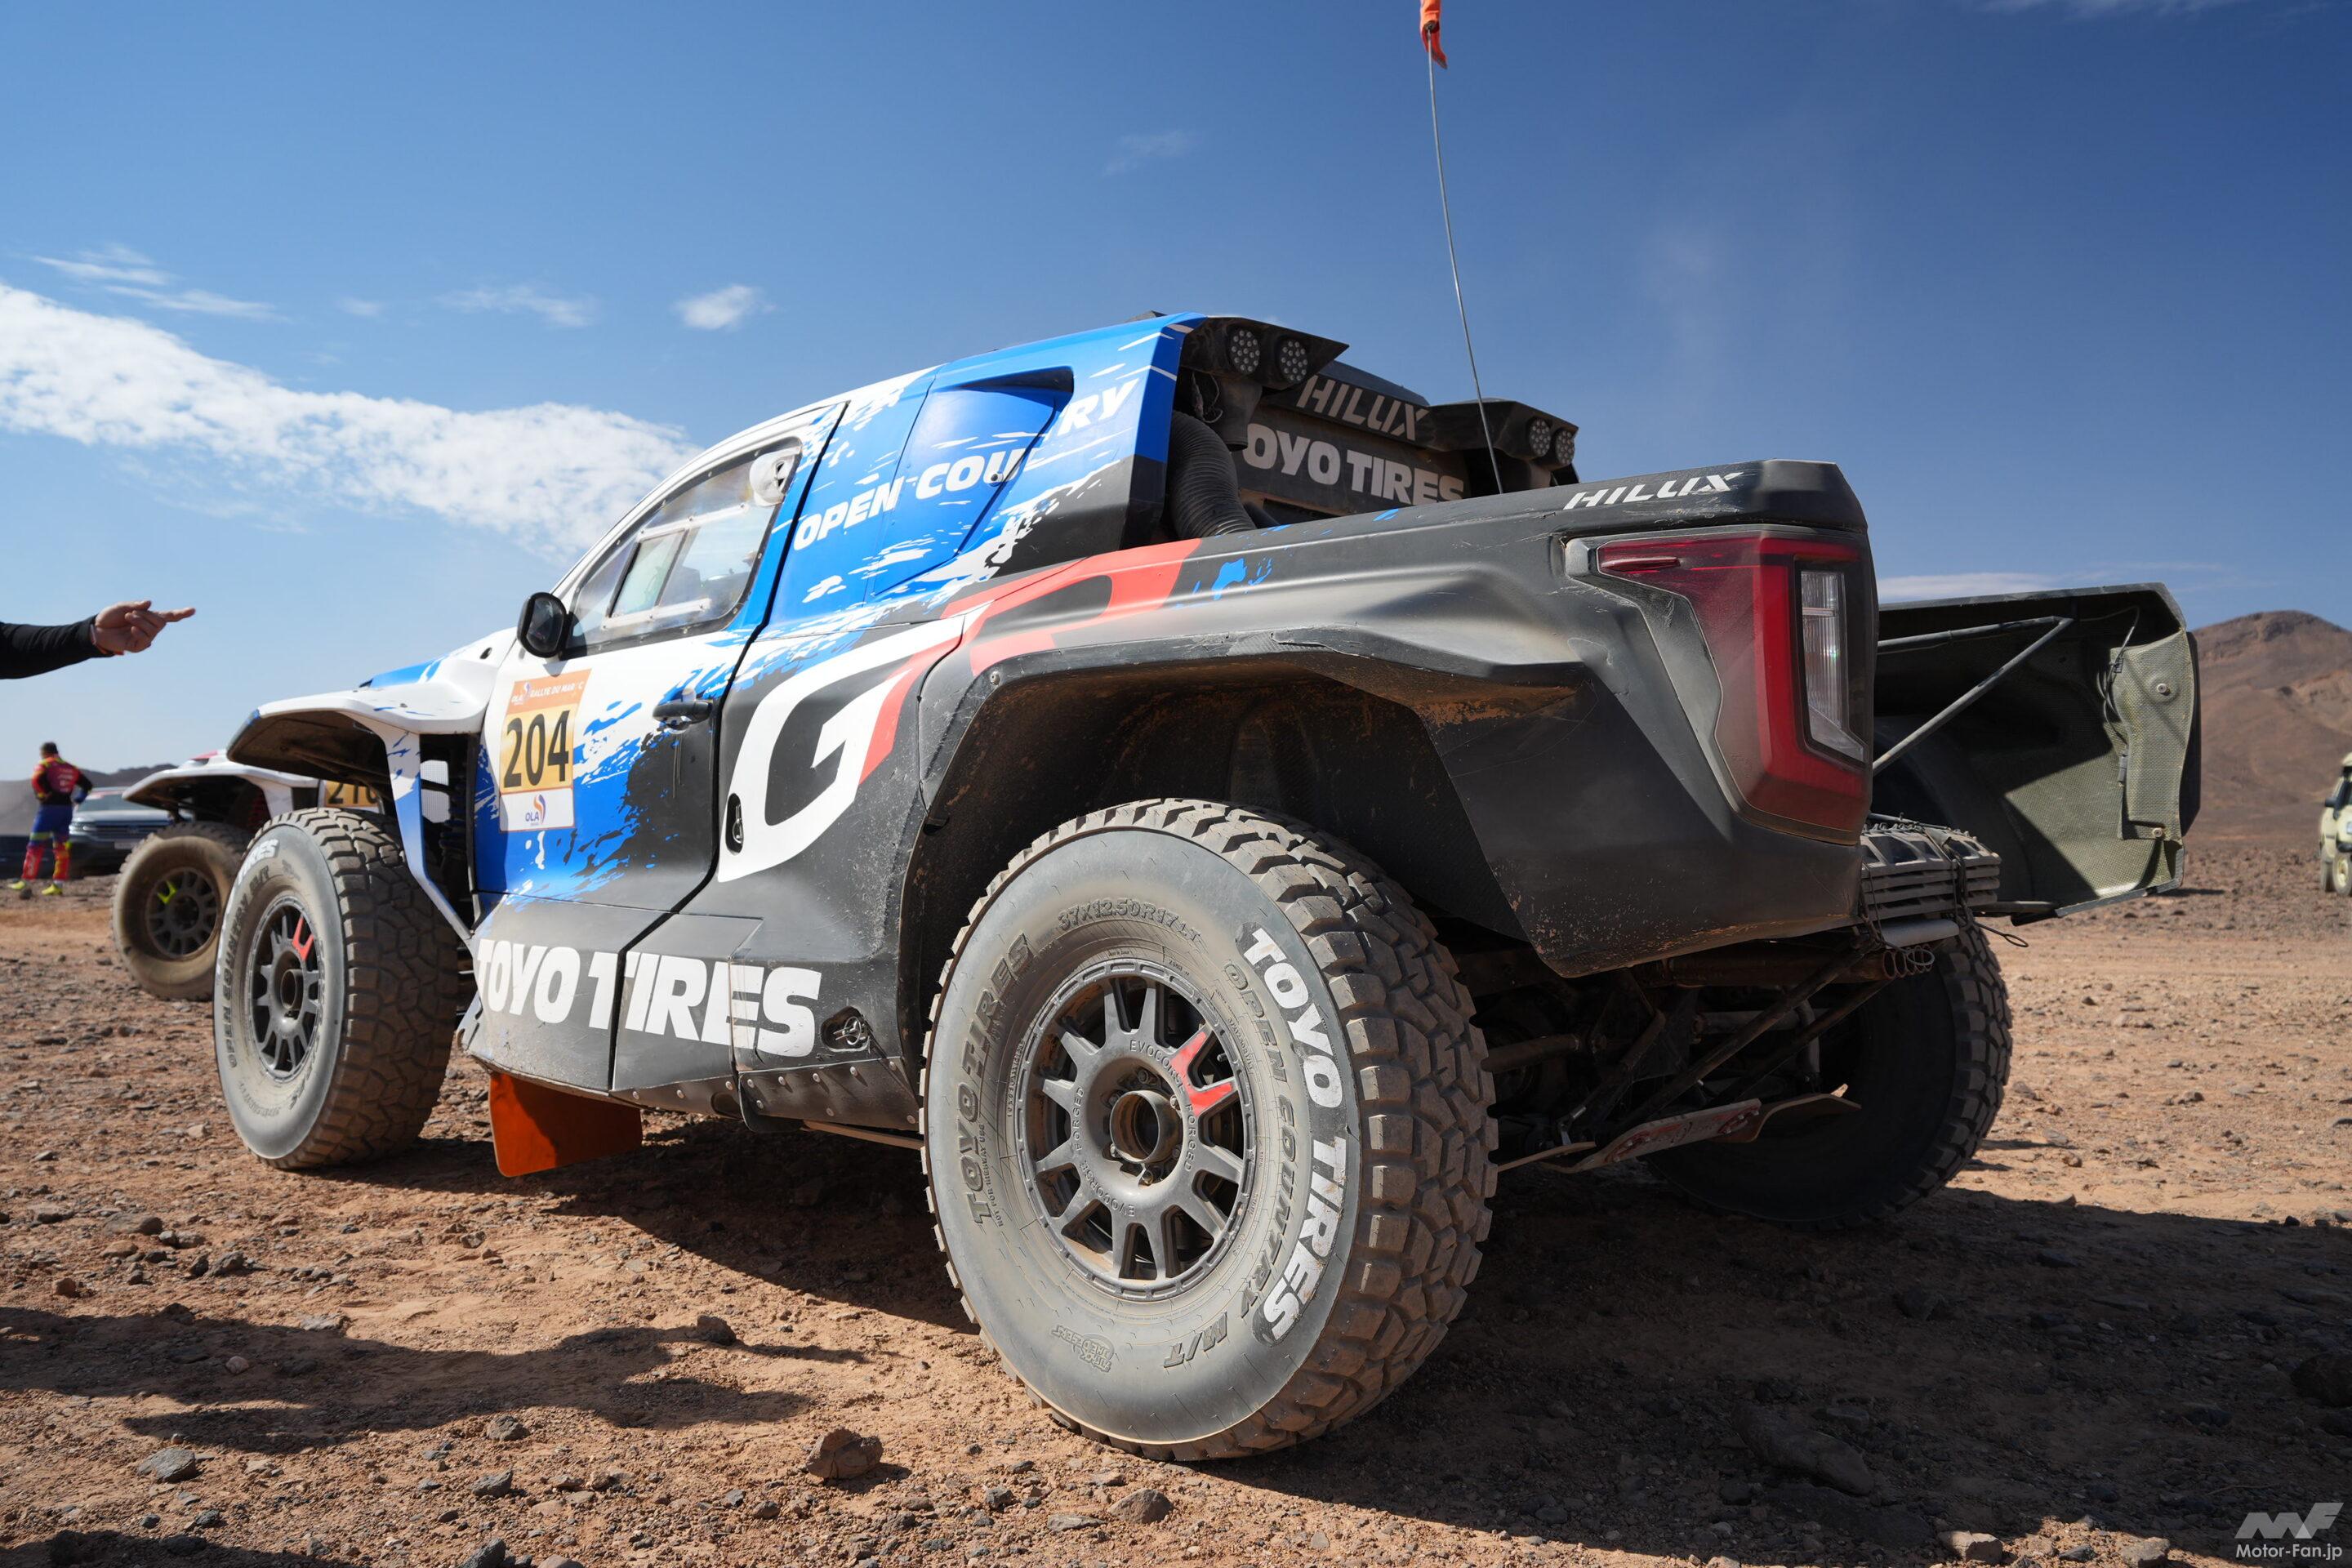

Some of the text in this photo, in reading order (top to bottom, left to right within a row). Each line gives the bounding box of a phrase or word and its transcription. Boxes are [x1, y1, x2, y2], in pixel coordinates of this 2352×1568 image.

[1296, 375, 1429, 441] HILUX
[793, 378, 1139, 550] OPEN COURY
[1243, 423, 1464, 506] OYO TIRES
[1563, 472, 1744, 510] HILUX
[561, 680, 585, 693] MARC
[503, 710, 571, 789] 204
[525, 811, 540, 822] OLA
[477, 938, 822, 1058] TOYO TIRES
[957, 933, 1035, 1225] TOYO TIRES
[1129, 1039, 1186, 1094] EVOCORSE
[1071, 1086, 1085, 1152] FORGED
[1185, 1102, 1197, 1172] FORGED
[1244, 928, 1347, 1341] TOYO TIRES
[1079, 1160, 1136, 1217] EVOCORSE
[1163, 962, 1297, 1369] OPEN COUNTRY M/T
